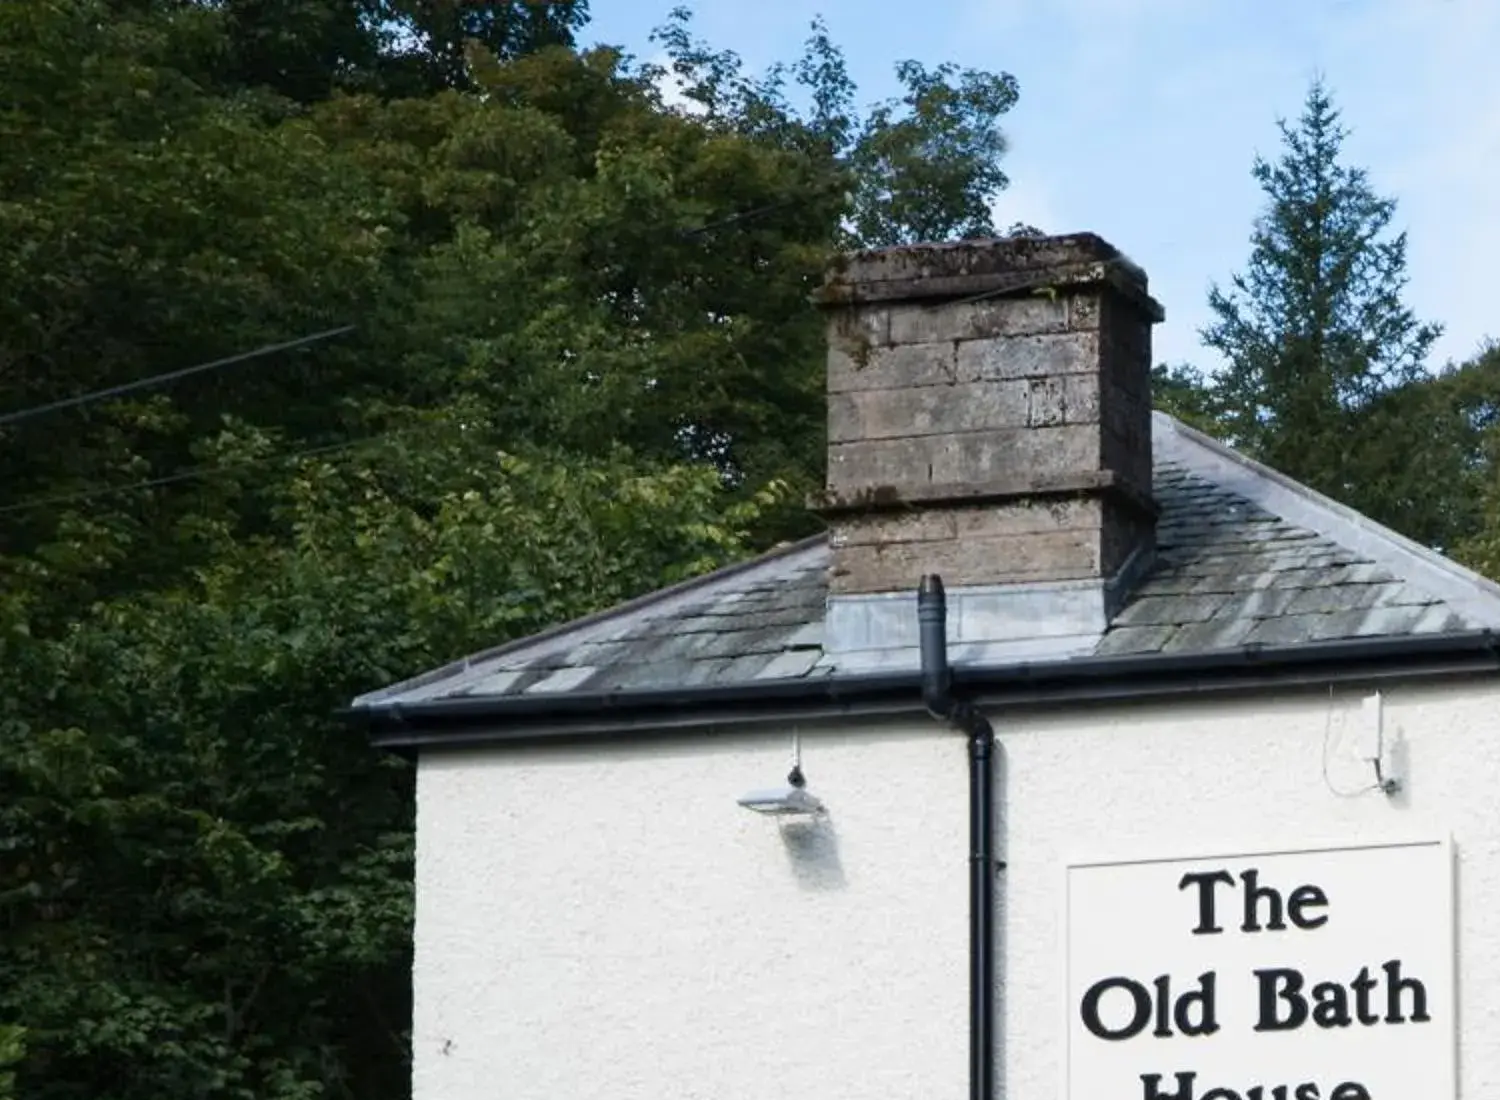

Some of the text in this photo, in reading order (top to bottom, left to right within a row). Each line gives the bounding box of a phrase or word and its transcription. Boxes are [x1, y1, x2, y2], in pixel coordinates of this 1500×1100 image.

[1178, 868, 1329, 935] The
[1080, 960, 1431, 1041] Old Bath
